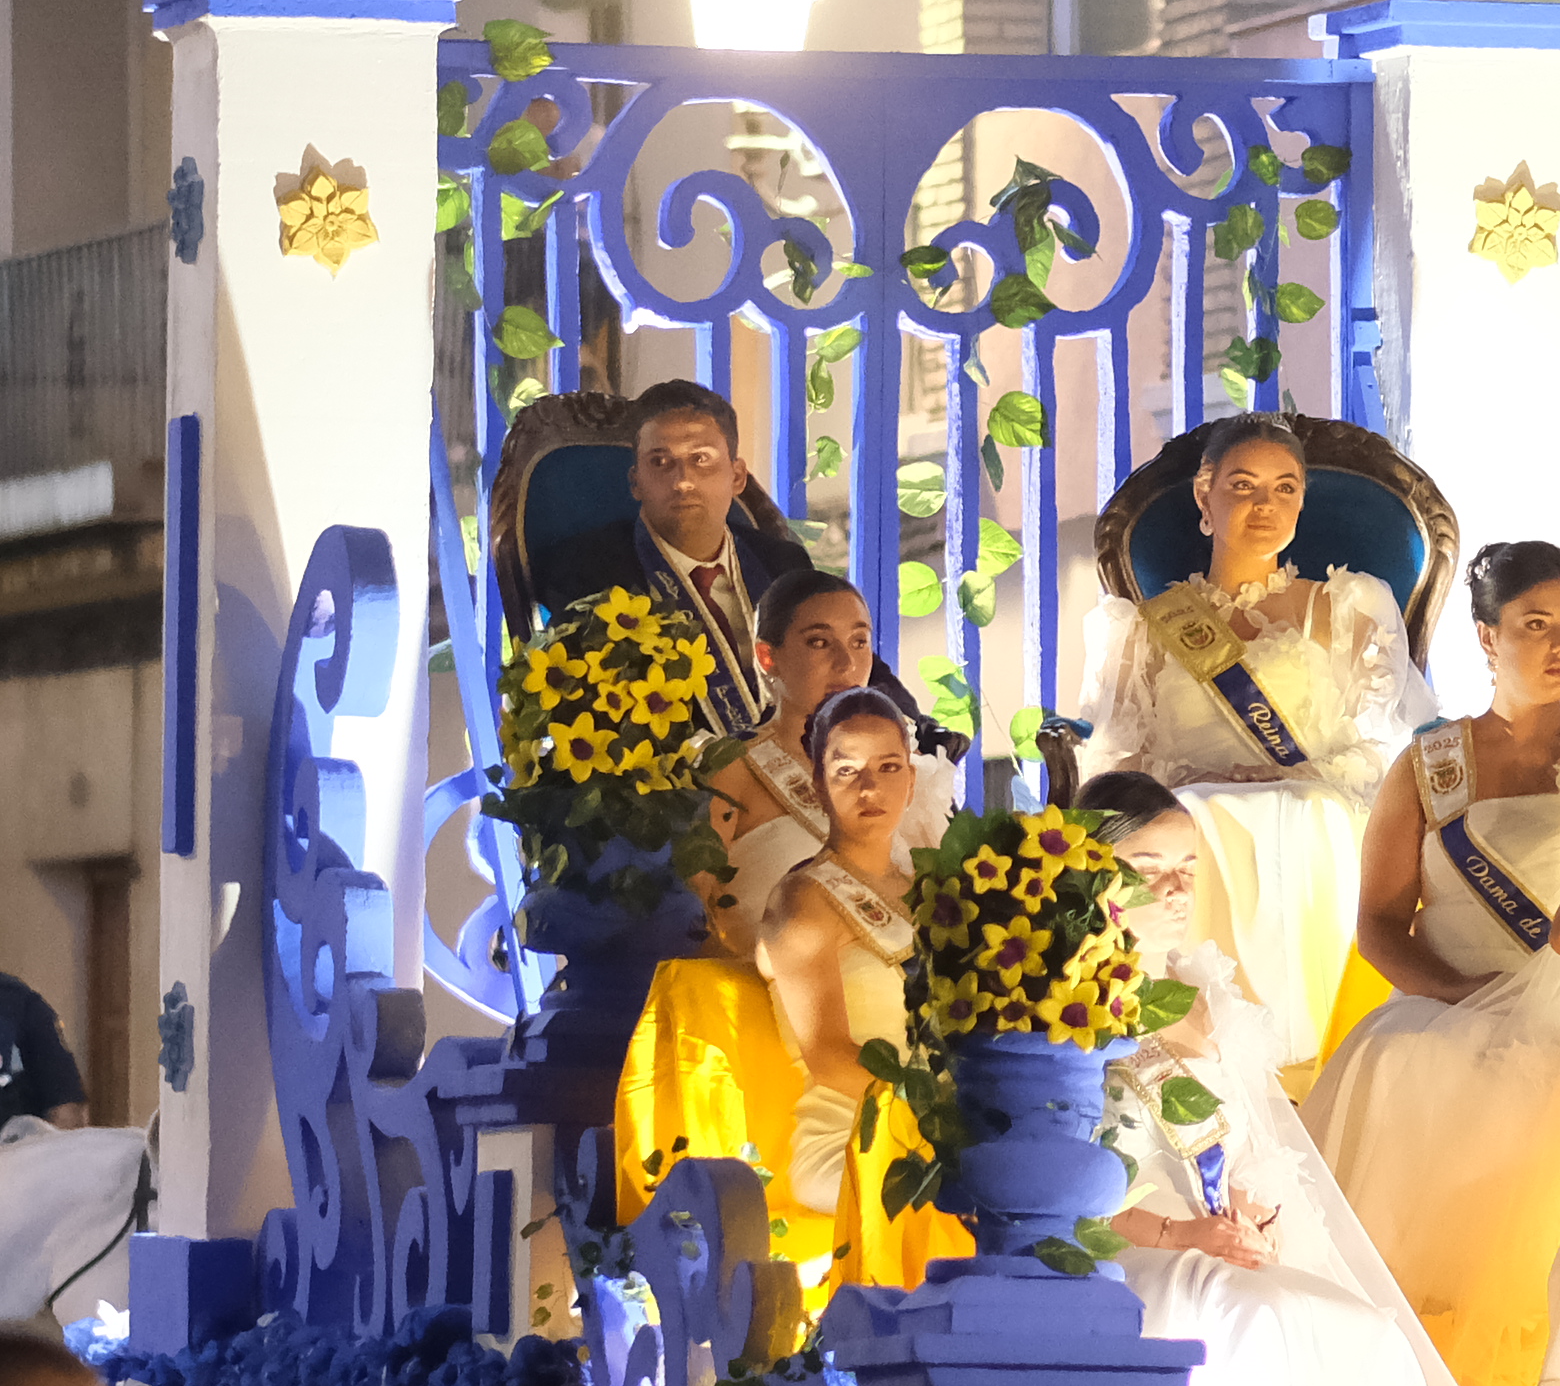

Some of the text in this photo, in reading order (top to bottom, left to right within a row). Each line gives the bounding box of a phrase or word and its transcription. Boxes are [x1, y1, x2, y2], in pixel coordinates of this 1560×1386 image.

[1247, 702, 1290, 760] Reina
[1424, 736, 1462, 755] 2025
[1466, 855, 1544, 939] Dama de
